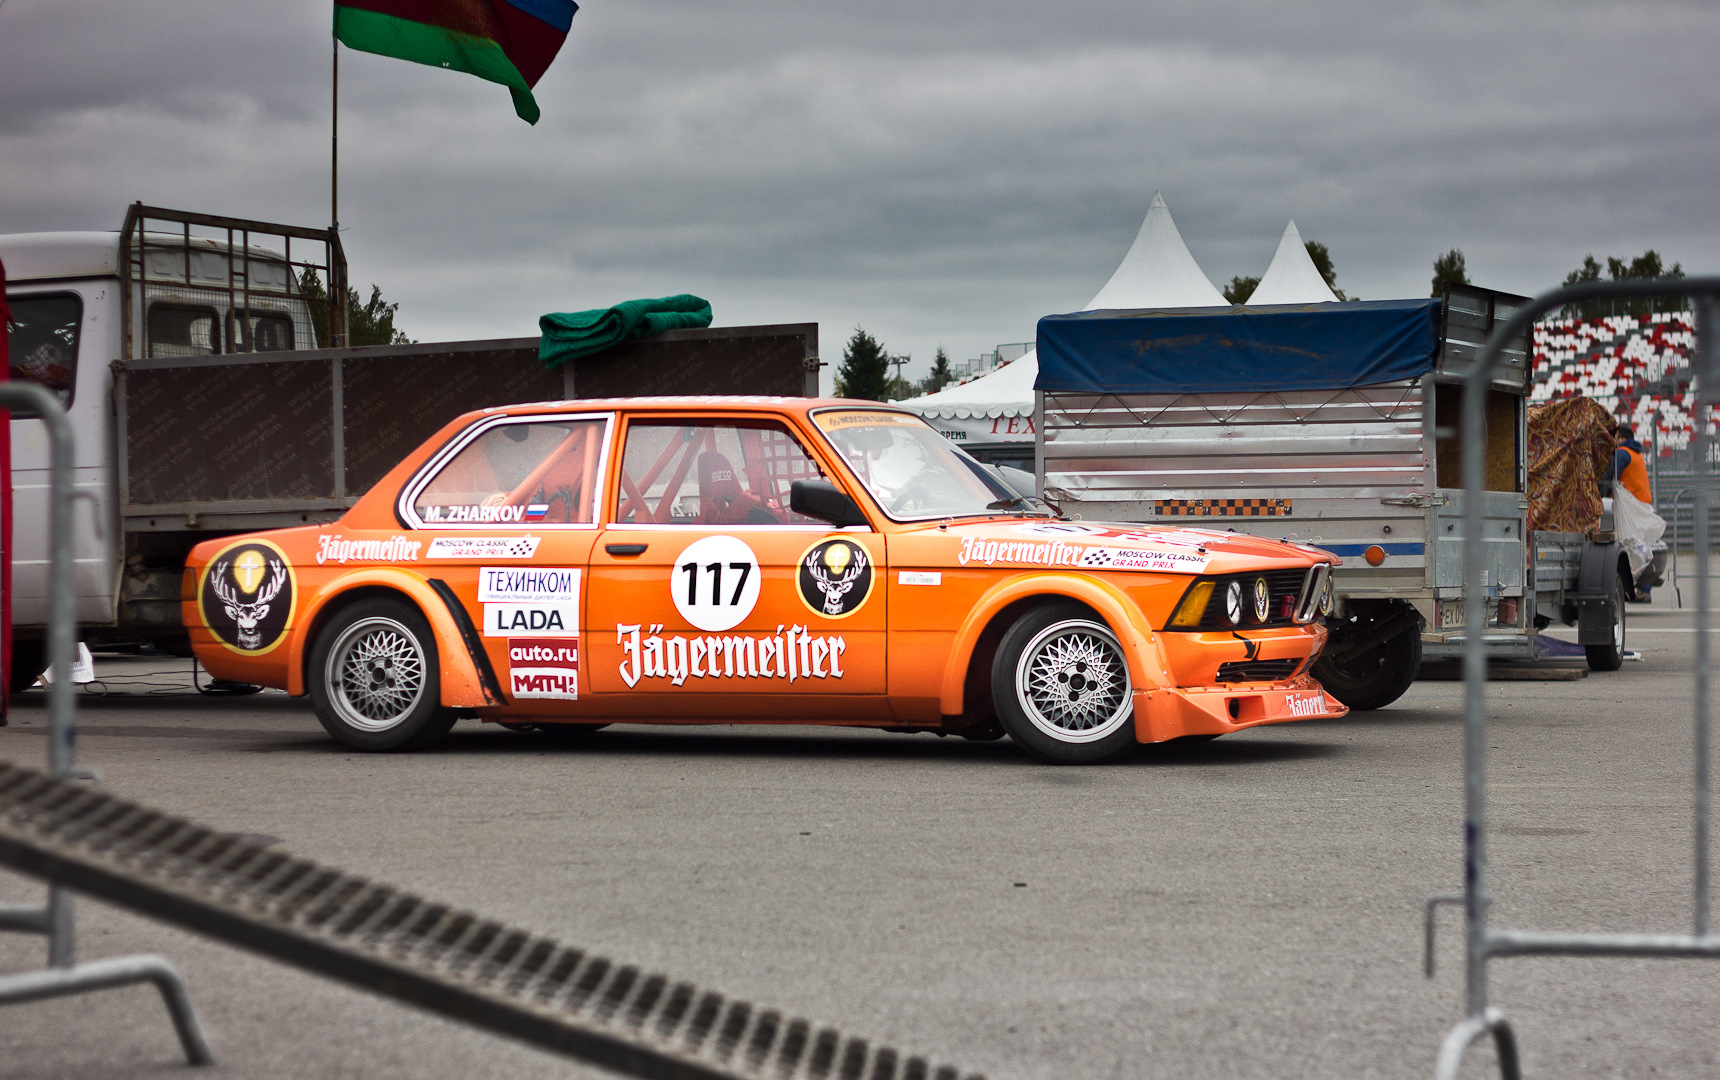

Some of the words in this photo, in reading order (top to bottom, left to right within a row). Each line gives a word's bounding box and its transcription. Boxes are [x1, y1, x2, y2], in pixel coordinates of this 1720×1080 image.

[425, 505, 444, 521] M.
[447, 505, 525, 521] ZHARKOV
[1116, 550, 1164, 560] MOSCOW
[1112, 560, 1149, 568] GRAND
[1151, 561, 1176, 569] PRIX
[488, 571, 572, 593] ТЕХИНКОМ
[681, 562, 751, 606] 117
[497, 610, 564, 630] LADA
[510, 645, 577, 662] auto.ru
